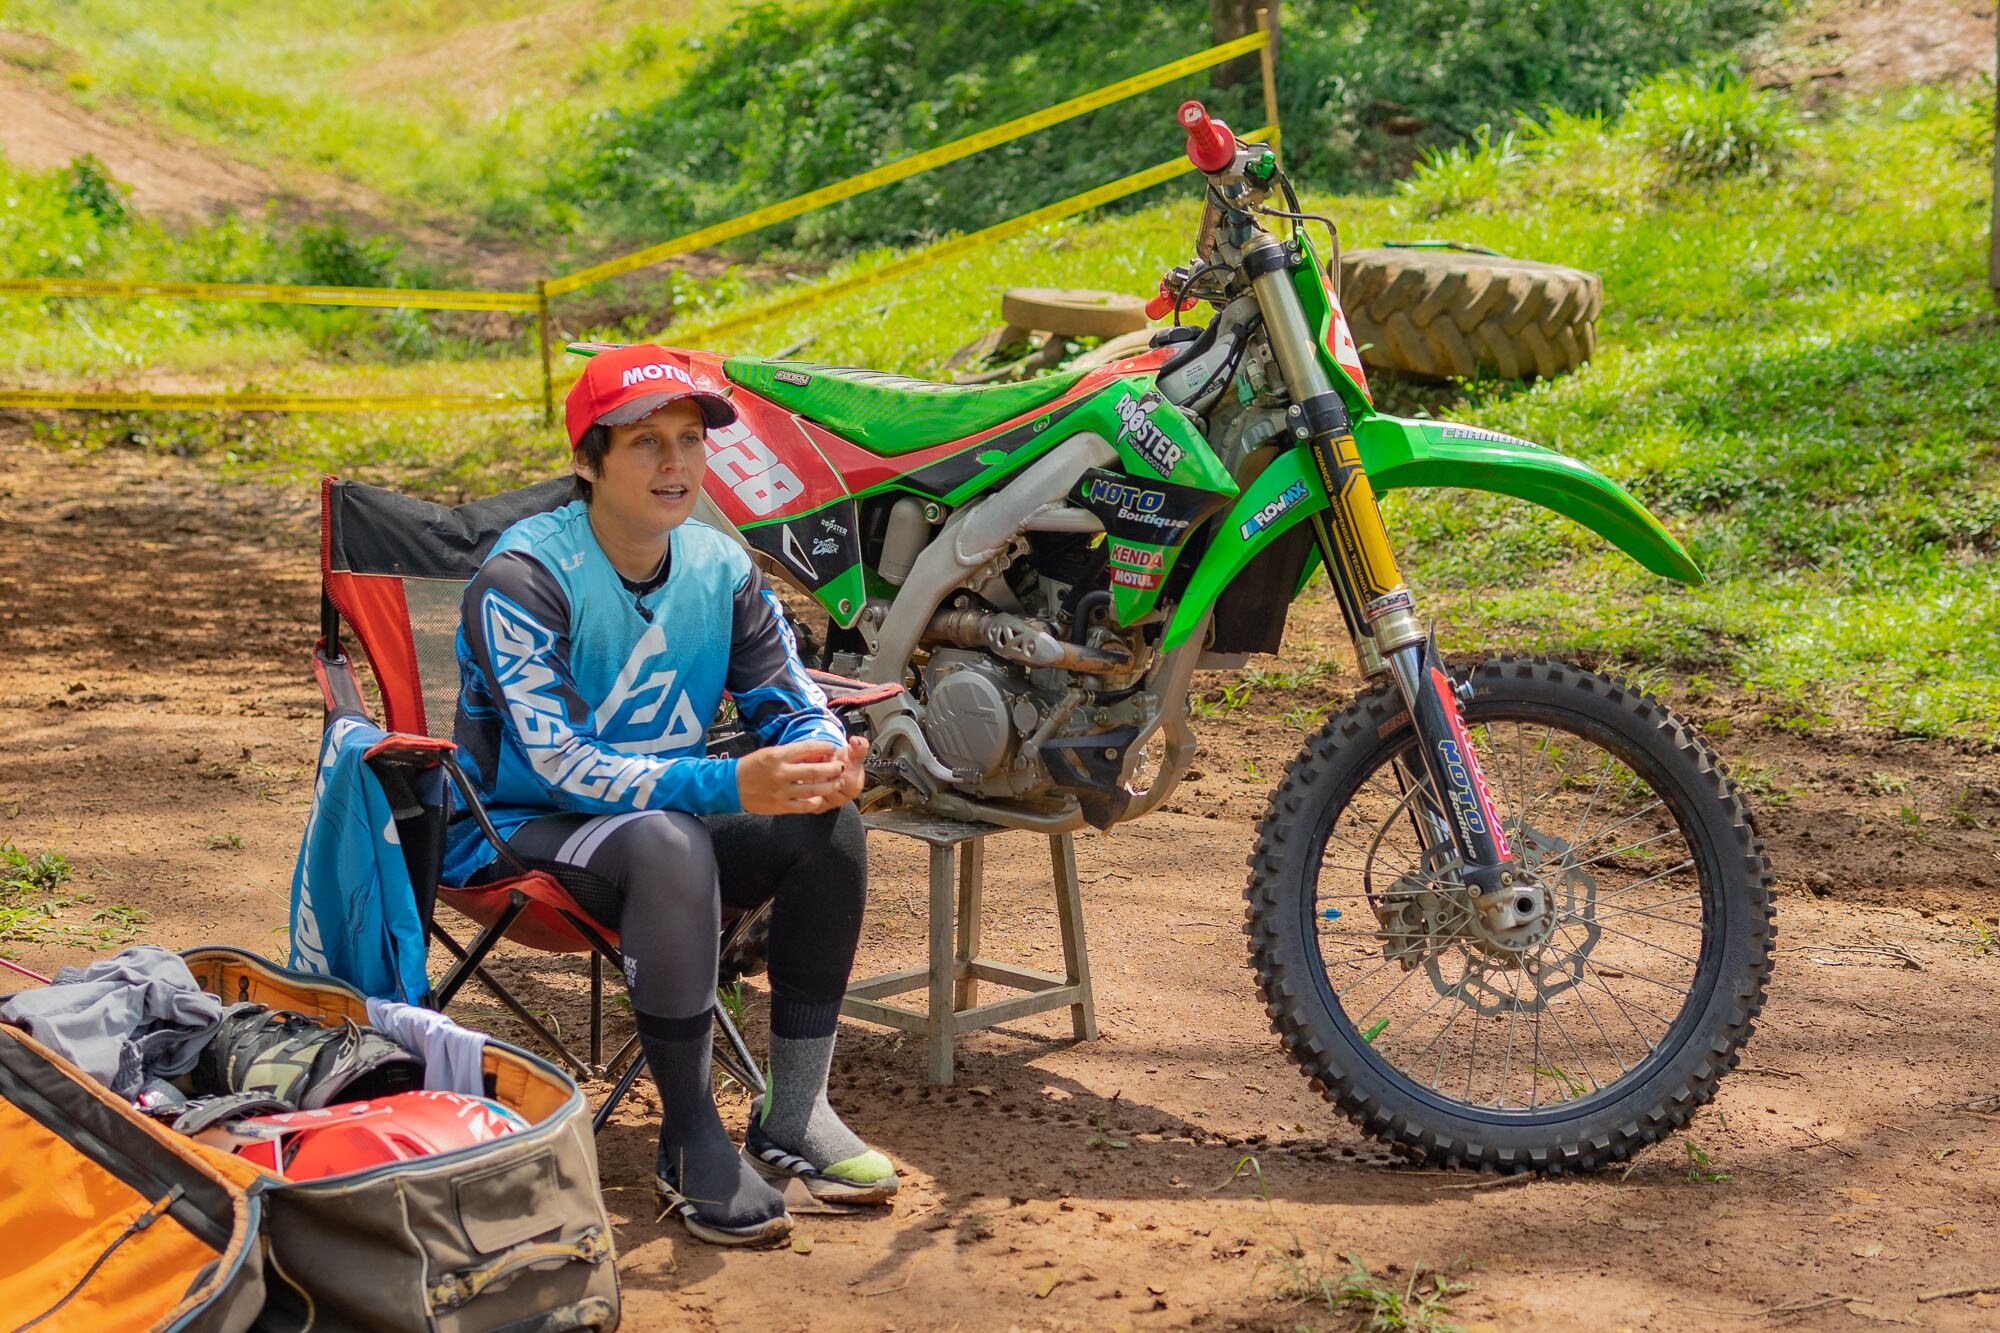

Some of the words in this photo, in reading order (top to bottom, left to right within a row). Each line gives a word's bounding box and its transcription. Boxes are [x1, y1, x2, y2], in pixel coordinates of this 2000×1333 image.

[1115, 391, 1182, 470] ROOSTER
[1143, 452, 1171, 479] BOOSTER
[1090, 479, 1166, 513] MOTO
[820, 519, 848, 535] ROOSTER
[1117, 508, 1190, 528] Boutique
[1313, 445, 1333, 493] ADVANCED
[1331, 494, 1354, 551] SUSPENSION
[1351, 553, 1372, 602] TECHNOLO
[1111, 543, 1164, 569] KENDA
[1114, 569, 1154, 587] MOTUL
[1377, 708, 1410, 739] KEND
[1438, 739, 1486, 834] MOTO
[1447, 789, 1477, 860] Boutique
